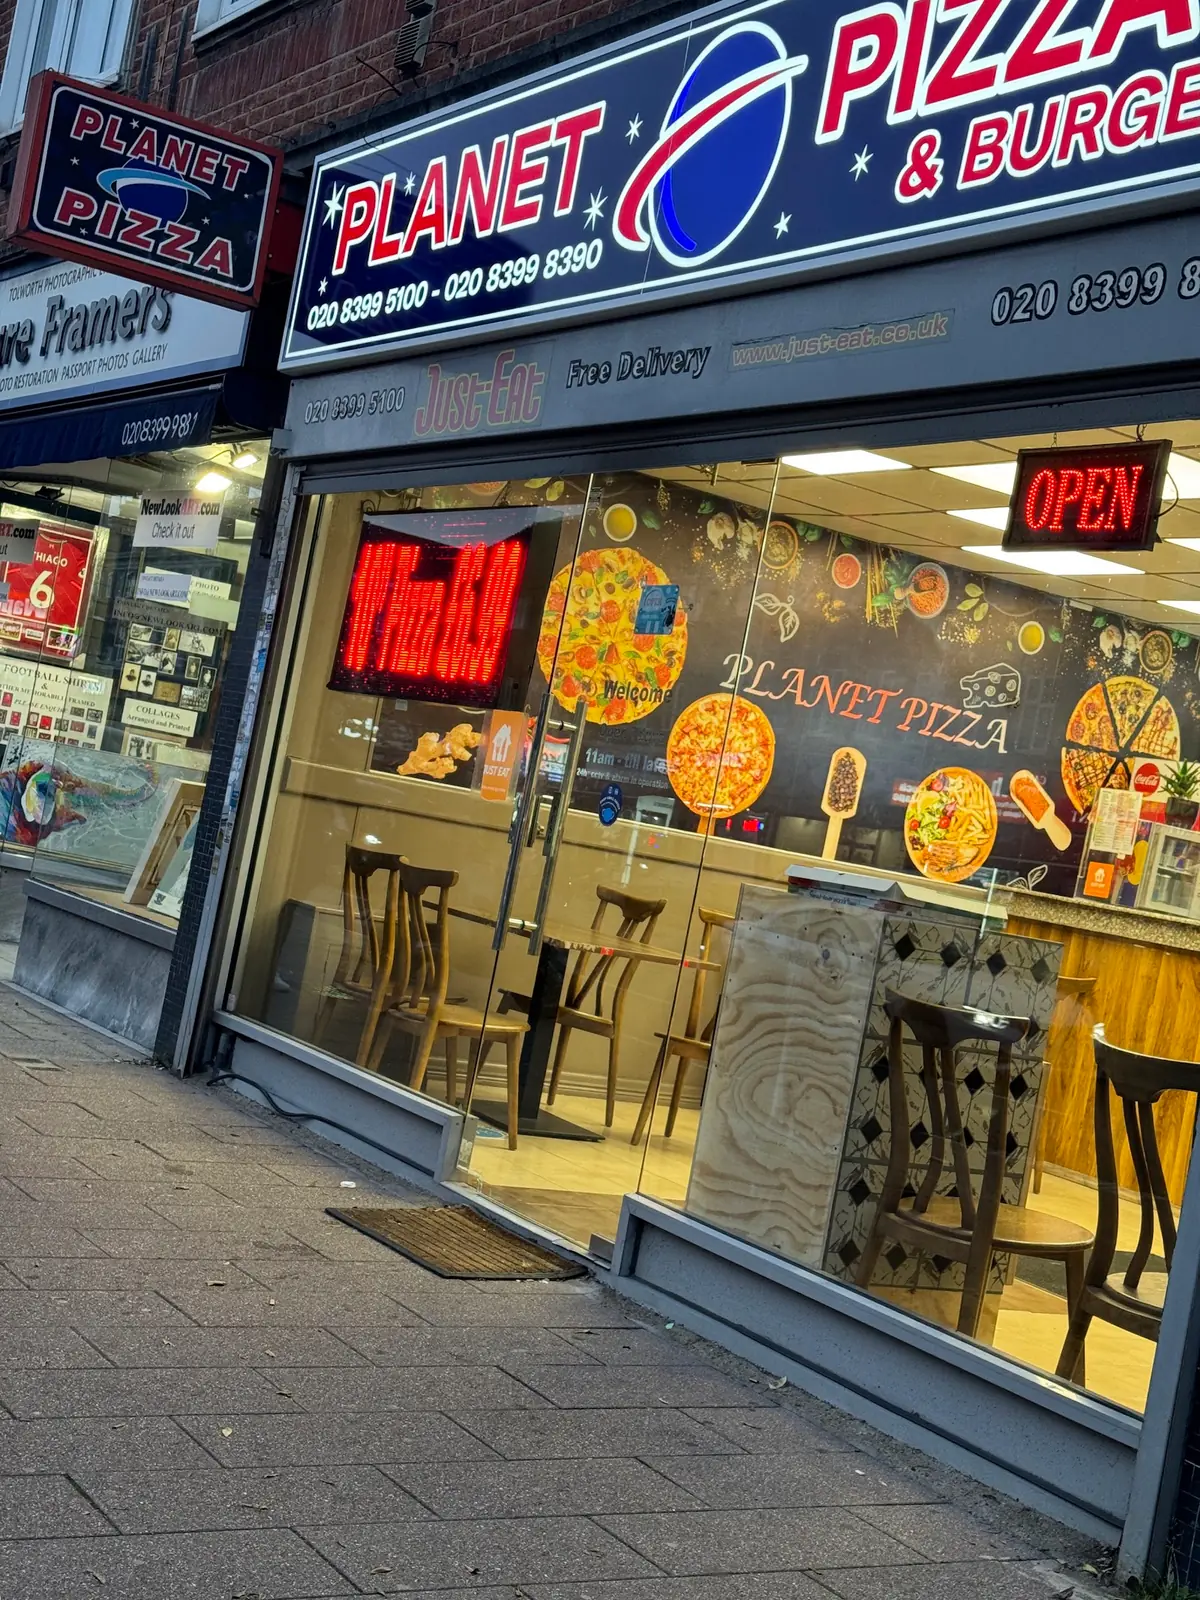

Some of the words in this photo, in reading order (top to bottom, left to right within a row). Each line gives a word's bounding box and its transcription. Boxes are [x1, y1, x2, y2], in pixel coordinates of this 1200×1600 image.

[70, 104, 250, 191] PLANET
[895, 129, 944, 204] &
[955, 60, 1200, 190] BURGE
[331, 100, 606, 276] PLANET
[53, 187, 234, 278] PIZZA
[9, 281, 43, 302] TOLWORTH
[43, 266, 97, 292] PHOTOGRAPHIC
[307, 301, 338, 330] 020
[340, 291, 382, 324] 8399
[385, 280, 428, 315] 5100
[444, 267, 483, 302] 020
[486, 253, 540, 293] 8399
[543, 238, 603, 279] 8390
[991, 279, 1058, 326] 020
[1067, 262, 1167, 315] 8399
[40, 284, 173, 358] Framers
[732, 312, 949, 367] www.just-eat.co.uk
[13, 368, 59, 389] RESTORATION
[61, 359, 97, 380] PASSPORT
[97, 352, 130, 373] PHOTOS
[132, 343, 169, 366] GALLERY
[565, 359, 612, 389] Free
[616, 344, 712, 380] Delivery
[304, 399, 328, 425] 020
[331, 391, 365, 420] 8399
[368, 387, 405, 415] 5100
[140, 498, 221, 516] NewLookART.com
[1025, 464, 1144, 532] OPEN
[152, 521, 175, 539] Check
[175, 523, 182, 539] it
[182, 523, 196, 539] out
[33, 551, 68, 568] HIAGO
[29, 570, 55, 609] 6
[194, 581, 220, 592] PHOTO
[4, 663, 61, 684] FOOTBALL
[603, 680, 673, 704] Welcome
[14, 699, 39, 709] PLESE
[127, 714, 155, 725] Arranged
[136, 705, 181, 720] COLLAGES
[718, 652, 903, 725] PLANET
[896, 696, 1008, 754] PIZZA
[497, 767, 510, 778] EAT
[585, 747, 615, 766] 11am
